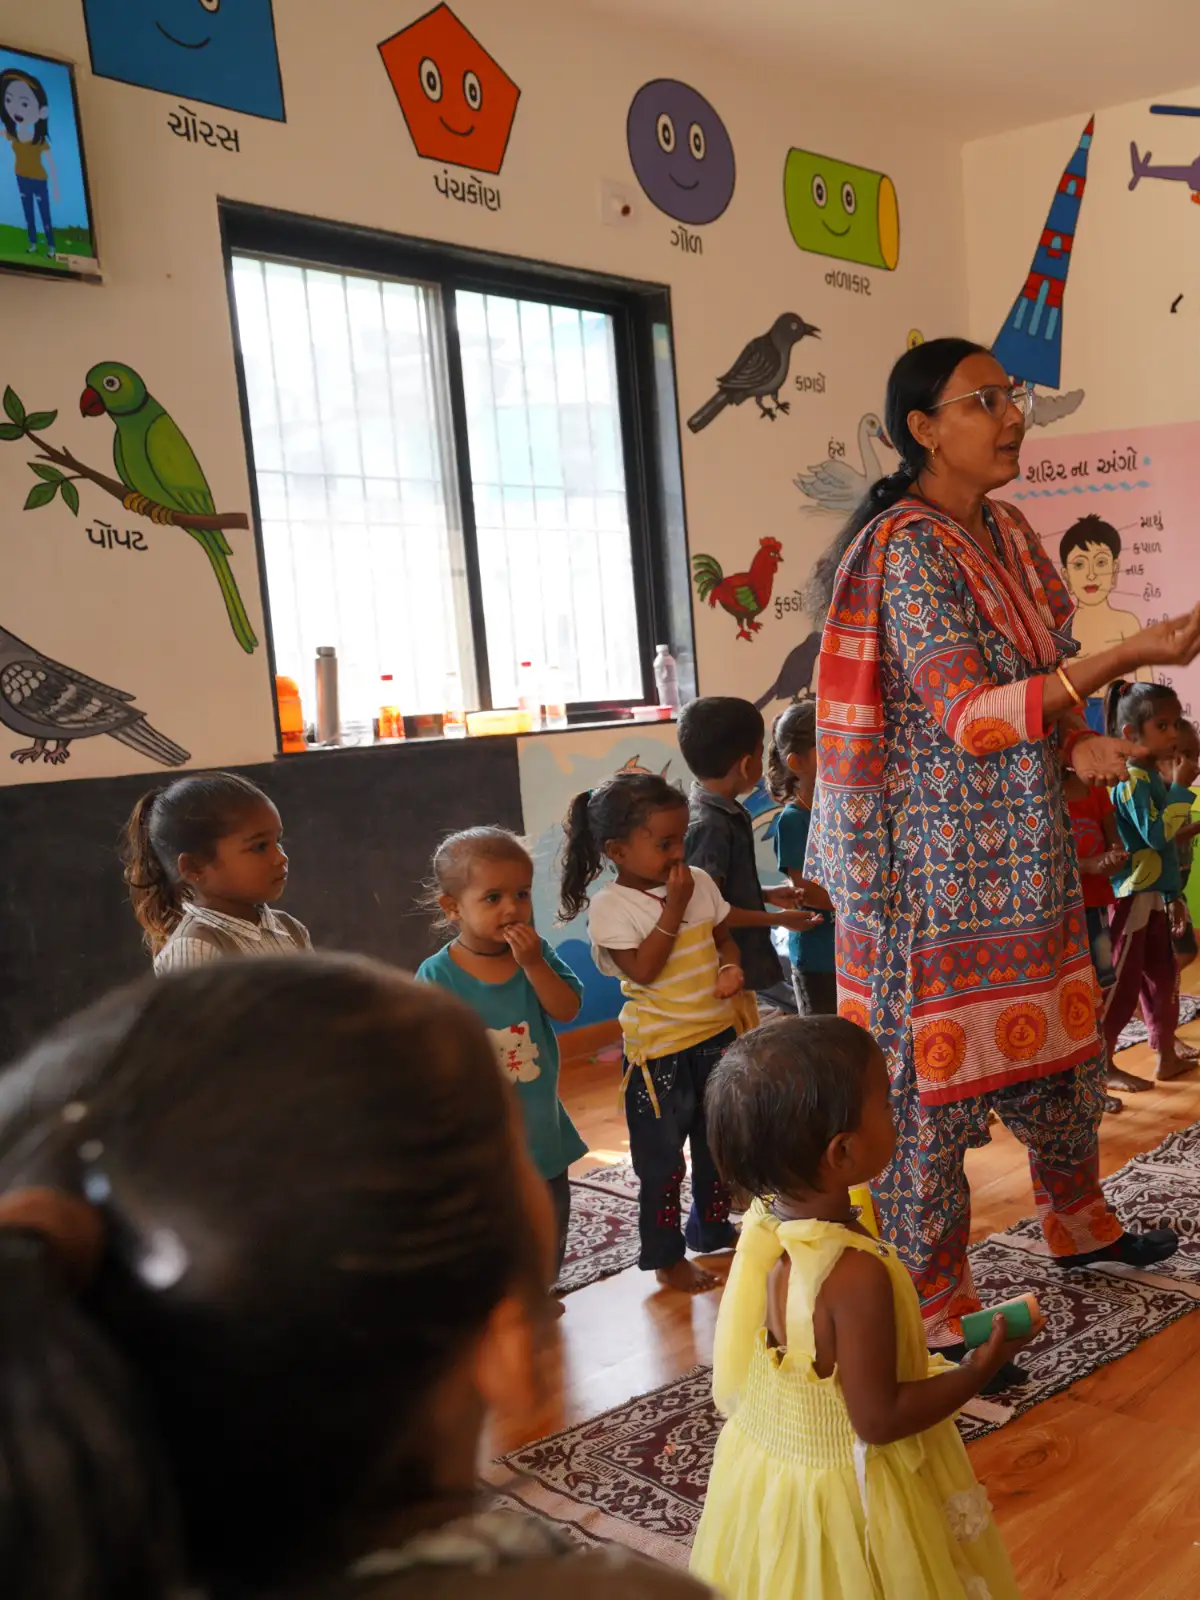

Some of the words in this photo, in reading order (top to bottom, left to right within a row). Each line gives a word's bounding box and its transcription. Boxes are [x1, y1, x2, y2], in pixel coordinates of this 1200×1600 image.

[166, 104, 241, 152] ચોરસ
[433, 168, 502, 211] પંચકોણ
[670, 225, 703, 255] ગોળ
[825, 269, 872, 296] નળાકાર
[1071, 458, 1090, 477] ના
[1096, 446, 1138, 475] અંગો
[85, 518, 149, 551] પોપટ
[583, 1421, 647, 1452] SHAGUN
